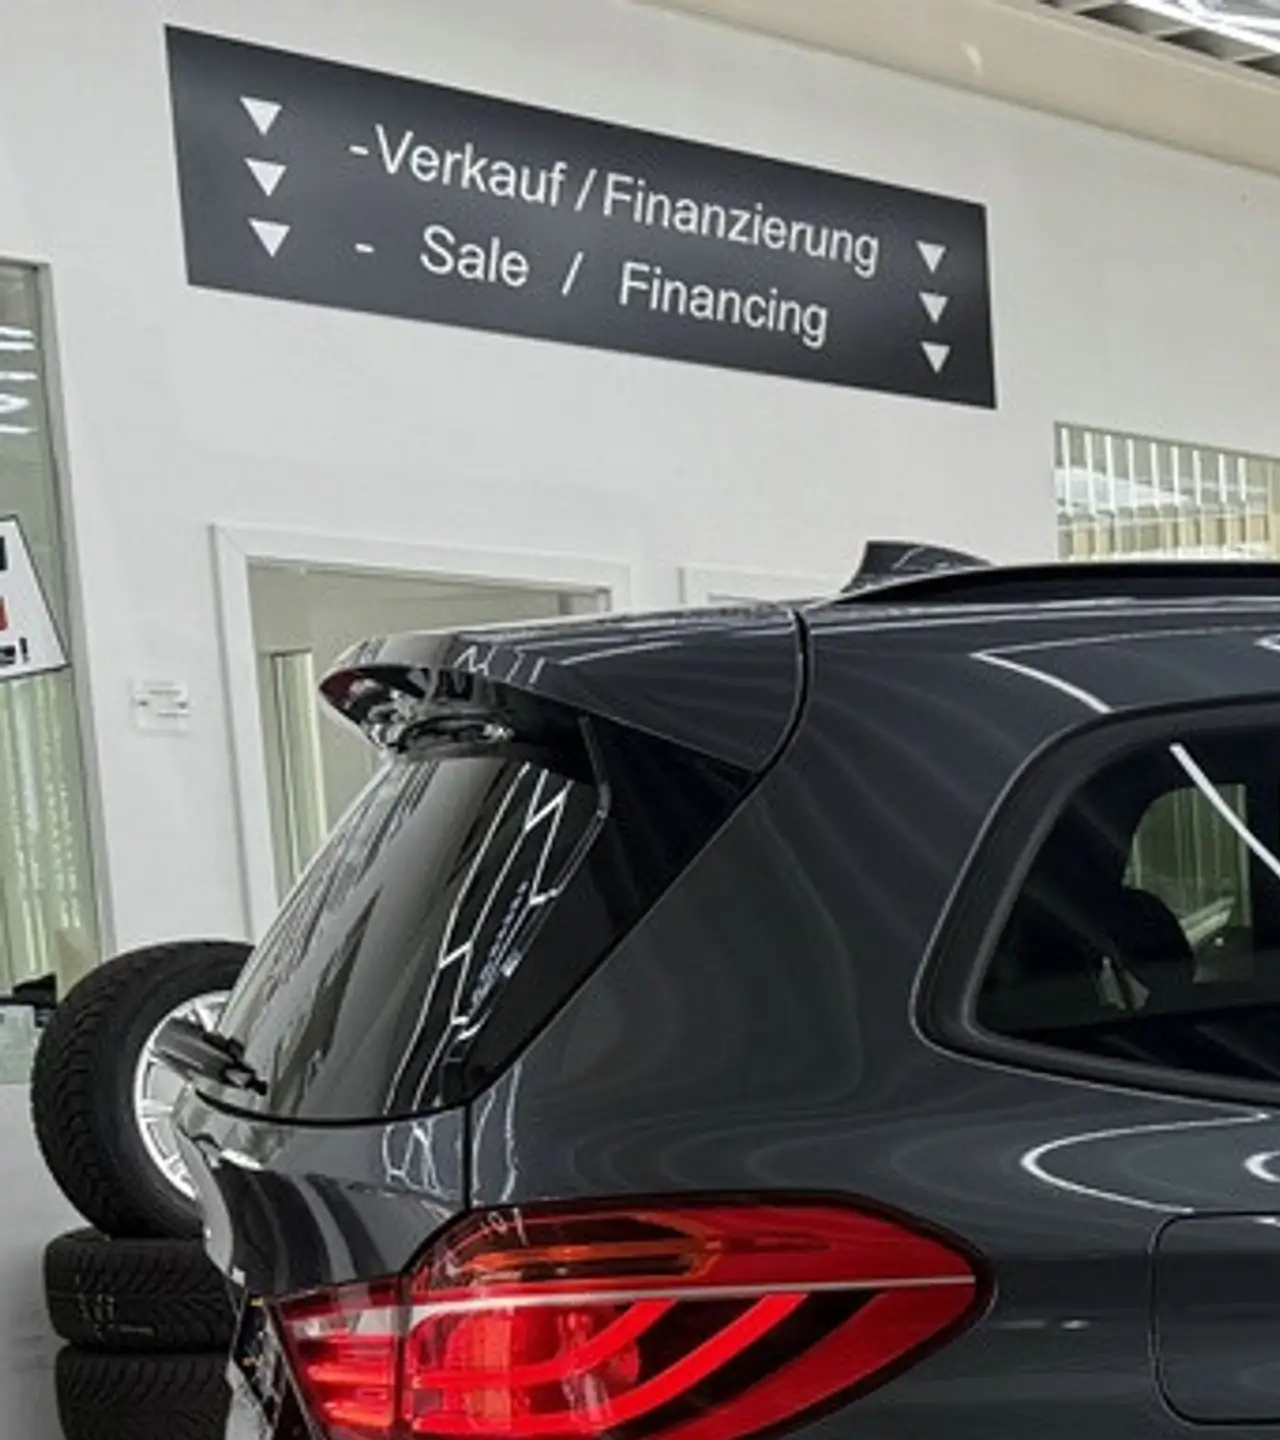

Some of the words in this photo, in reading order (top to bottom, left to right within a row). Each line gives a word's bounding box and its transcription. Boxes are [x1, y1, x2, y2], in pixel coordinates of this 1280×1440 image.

[603, 171, 879, 278] Finanzierung
[420, 224, 529, 287] Sale
[619, 261, 829, 350] Financing
